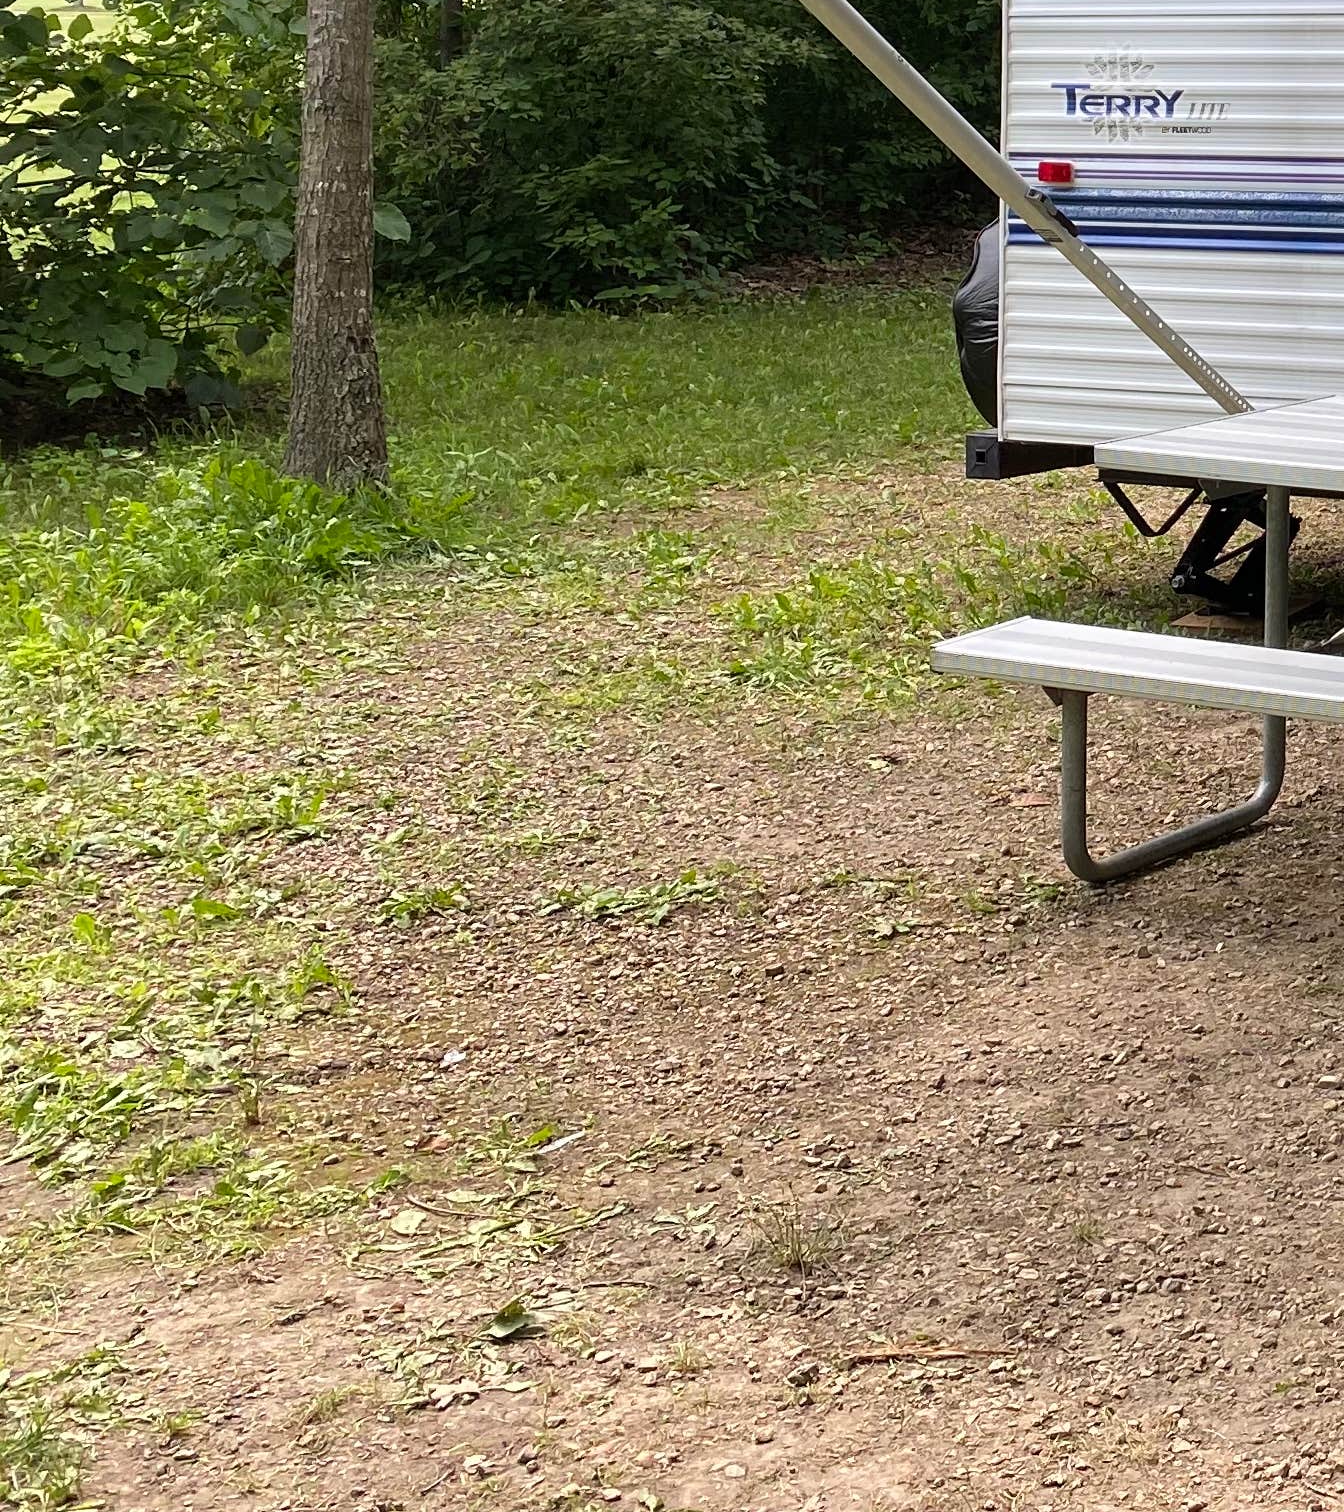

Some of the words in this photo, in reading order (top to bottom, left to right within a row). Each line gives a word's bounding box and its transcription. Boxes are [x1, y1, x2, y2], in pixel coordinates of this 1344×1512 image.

[1050, 82, 1185, 119] TERRY
[1185, 102, 1232, 121] LITE
[1172, 126, 1212, 134] FLEETWOOD
